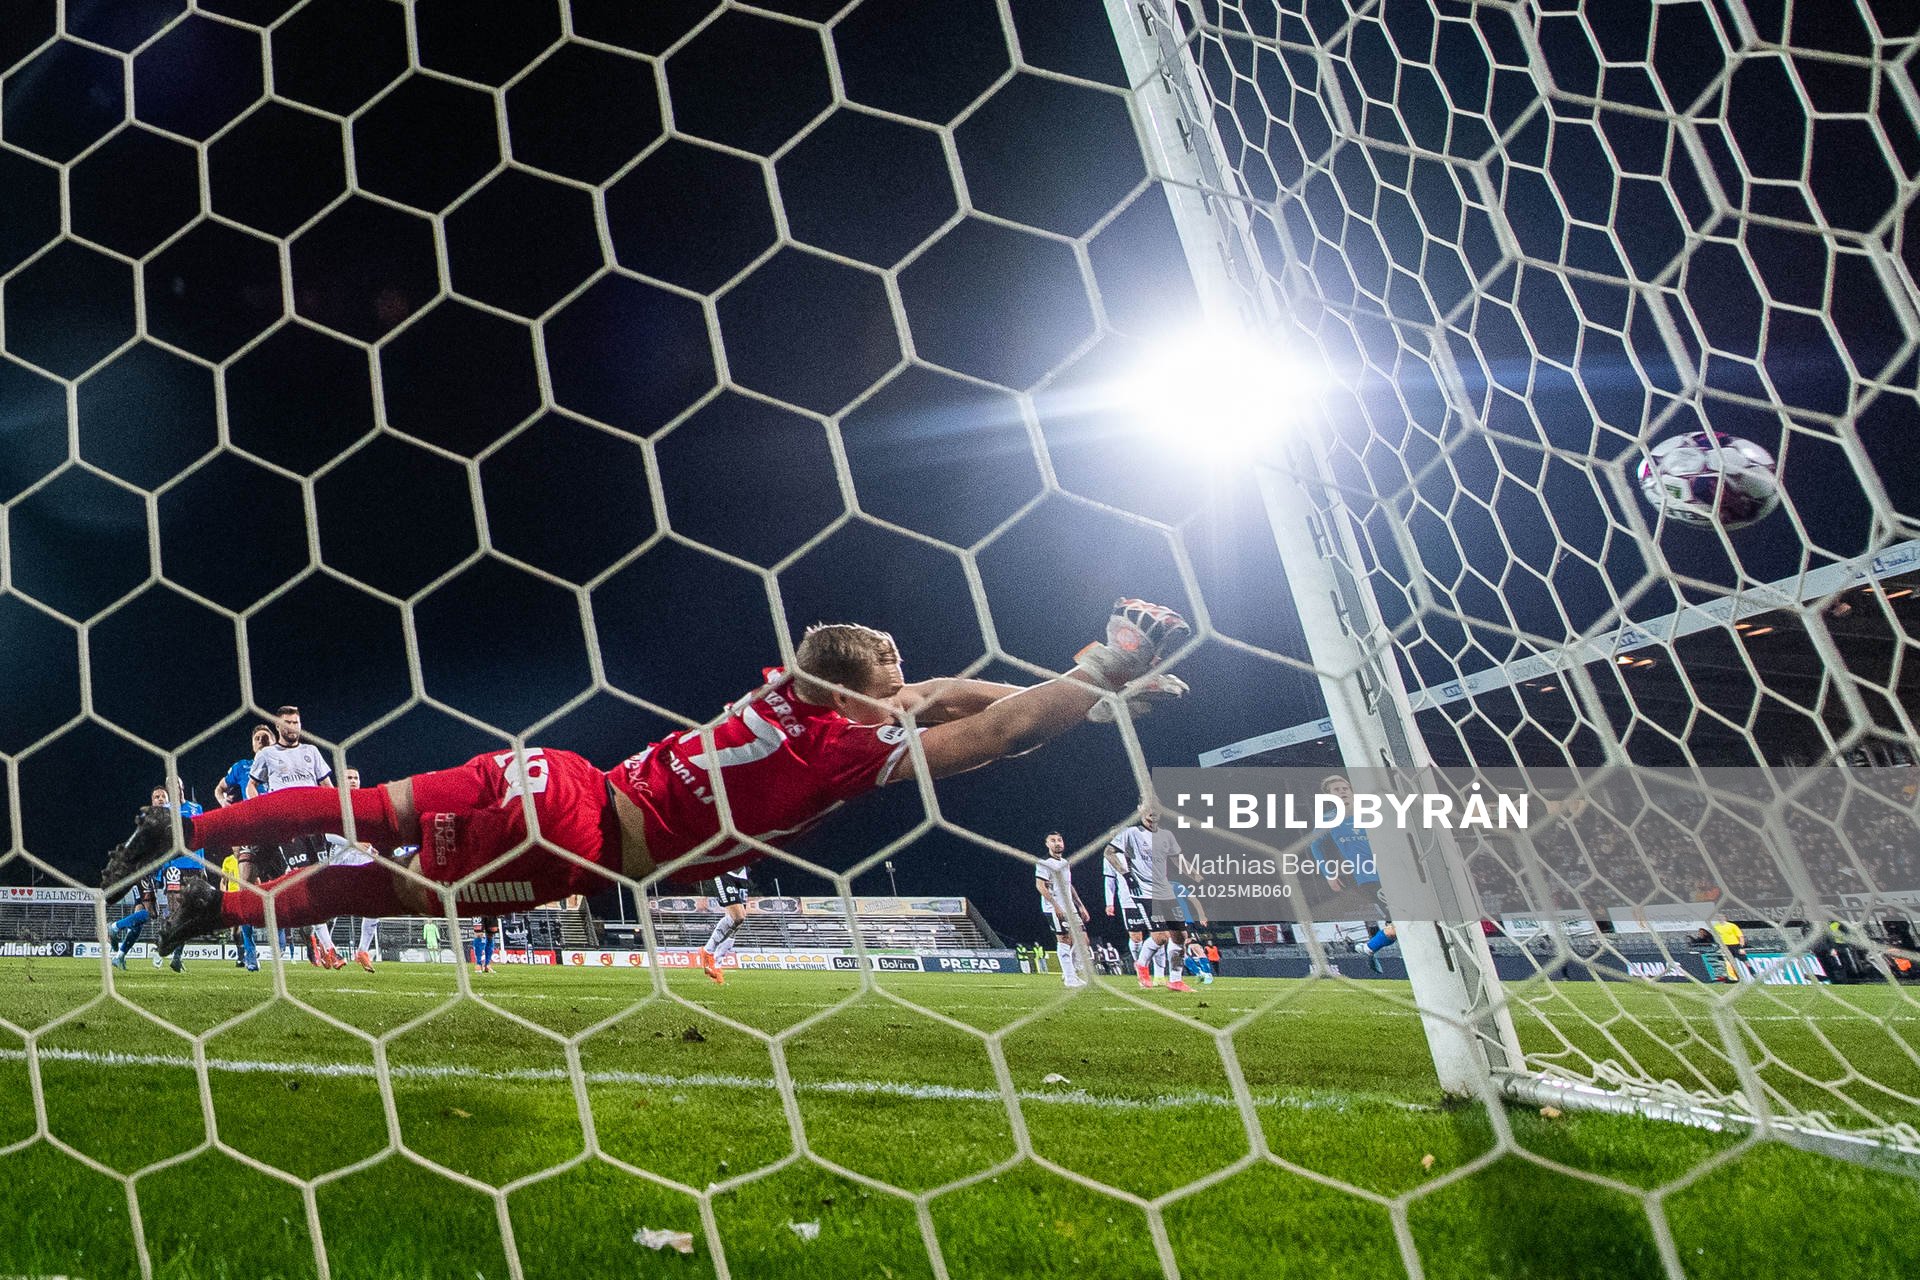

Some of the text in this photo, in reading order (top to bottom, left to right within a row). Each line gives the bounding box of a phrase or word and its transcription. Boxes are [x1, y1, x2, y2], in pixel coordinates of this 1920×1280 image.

[36, 890, 95, 901] HALMSTA
[183, 948, 219, 958] ygg Syd
[656, 954, 689, 965] enta
[939, 958, 1001, 970] PREFAB
